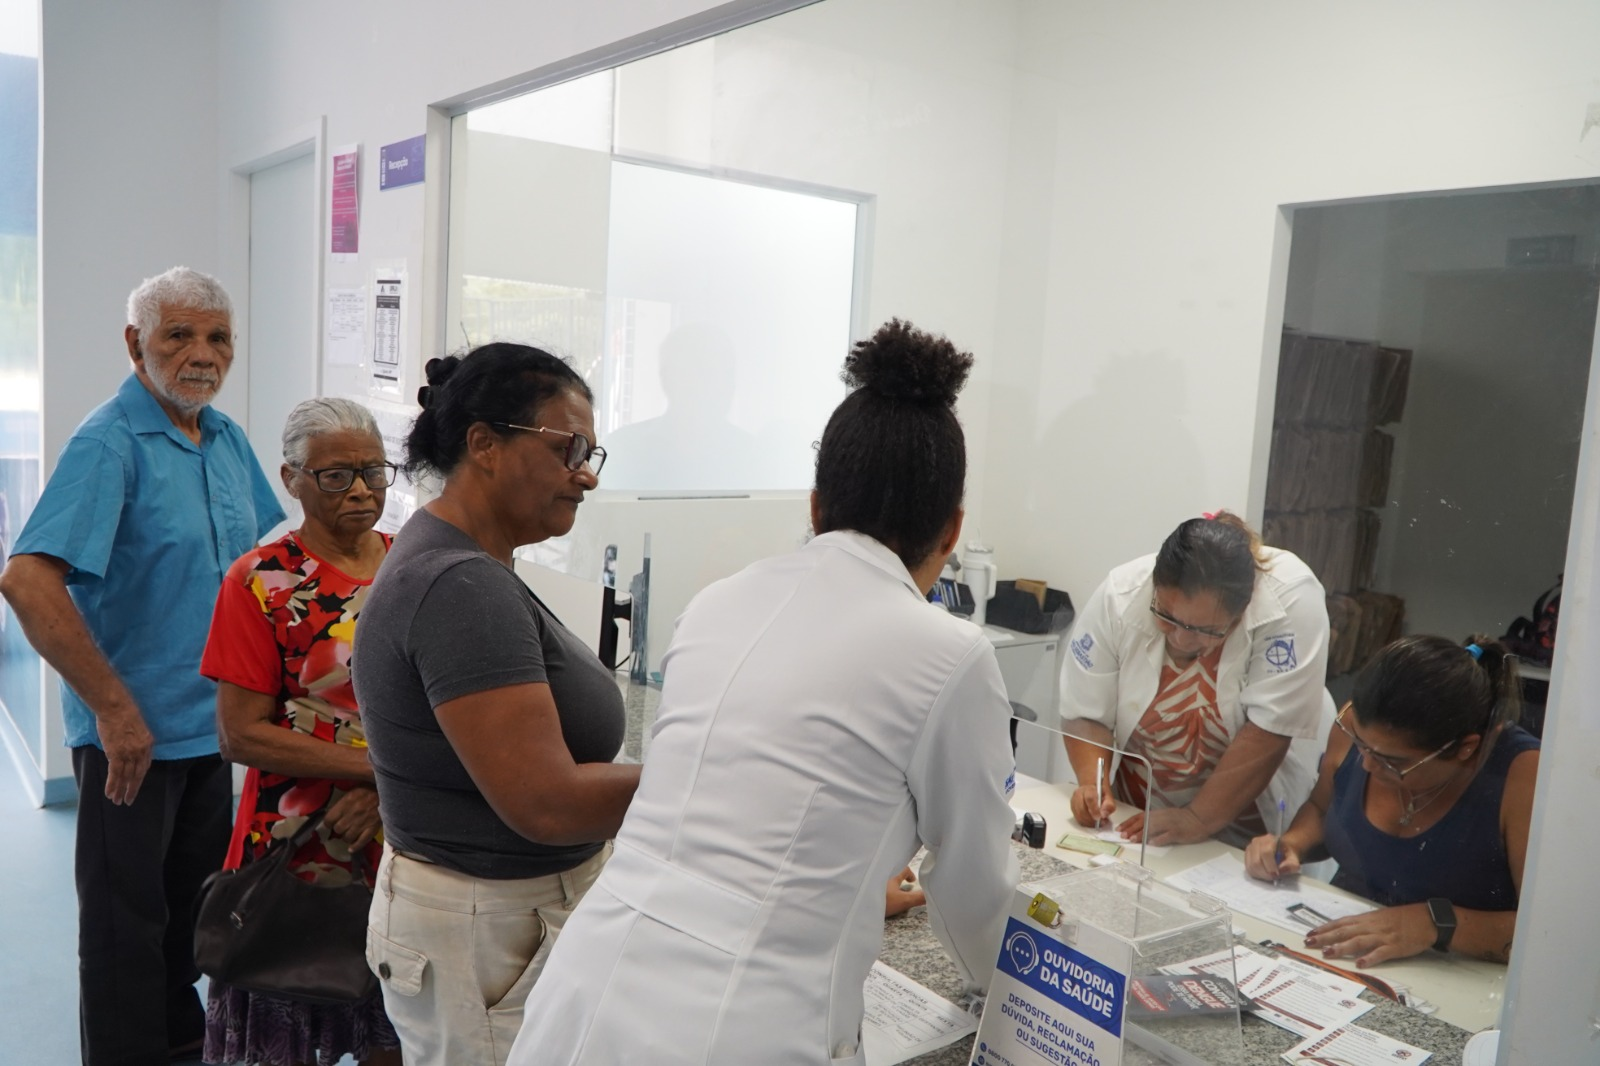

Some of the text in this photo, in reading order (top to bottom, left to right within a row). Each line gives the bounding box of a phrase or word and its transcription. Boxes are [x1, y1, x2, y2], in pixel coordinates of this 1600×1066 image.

[1040, 965, 1060, 989] DA
[1061, 976, 1113, 1018] SAÚDE
[1043, 948, 1116, 999] OUVIDORIA
[1182, 980, 1227, 1009] DENGUE
[1001, 1002, 1100, 1066] DÚVIDA, RECLAMAÇÃO
[1008, 992, 1095, 1051] DEPOSITE AQUI SUA
[1016, 1028, 1029, 1044] OU
